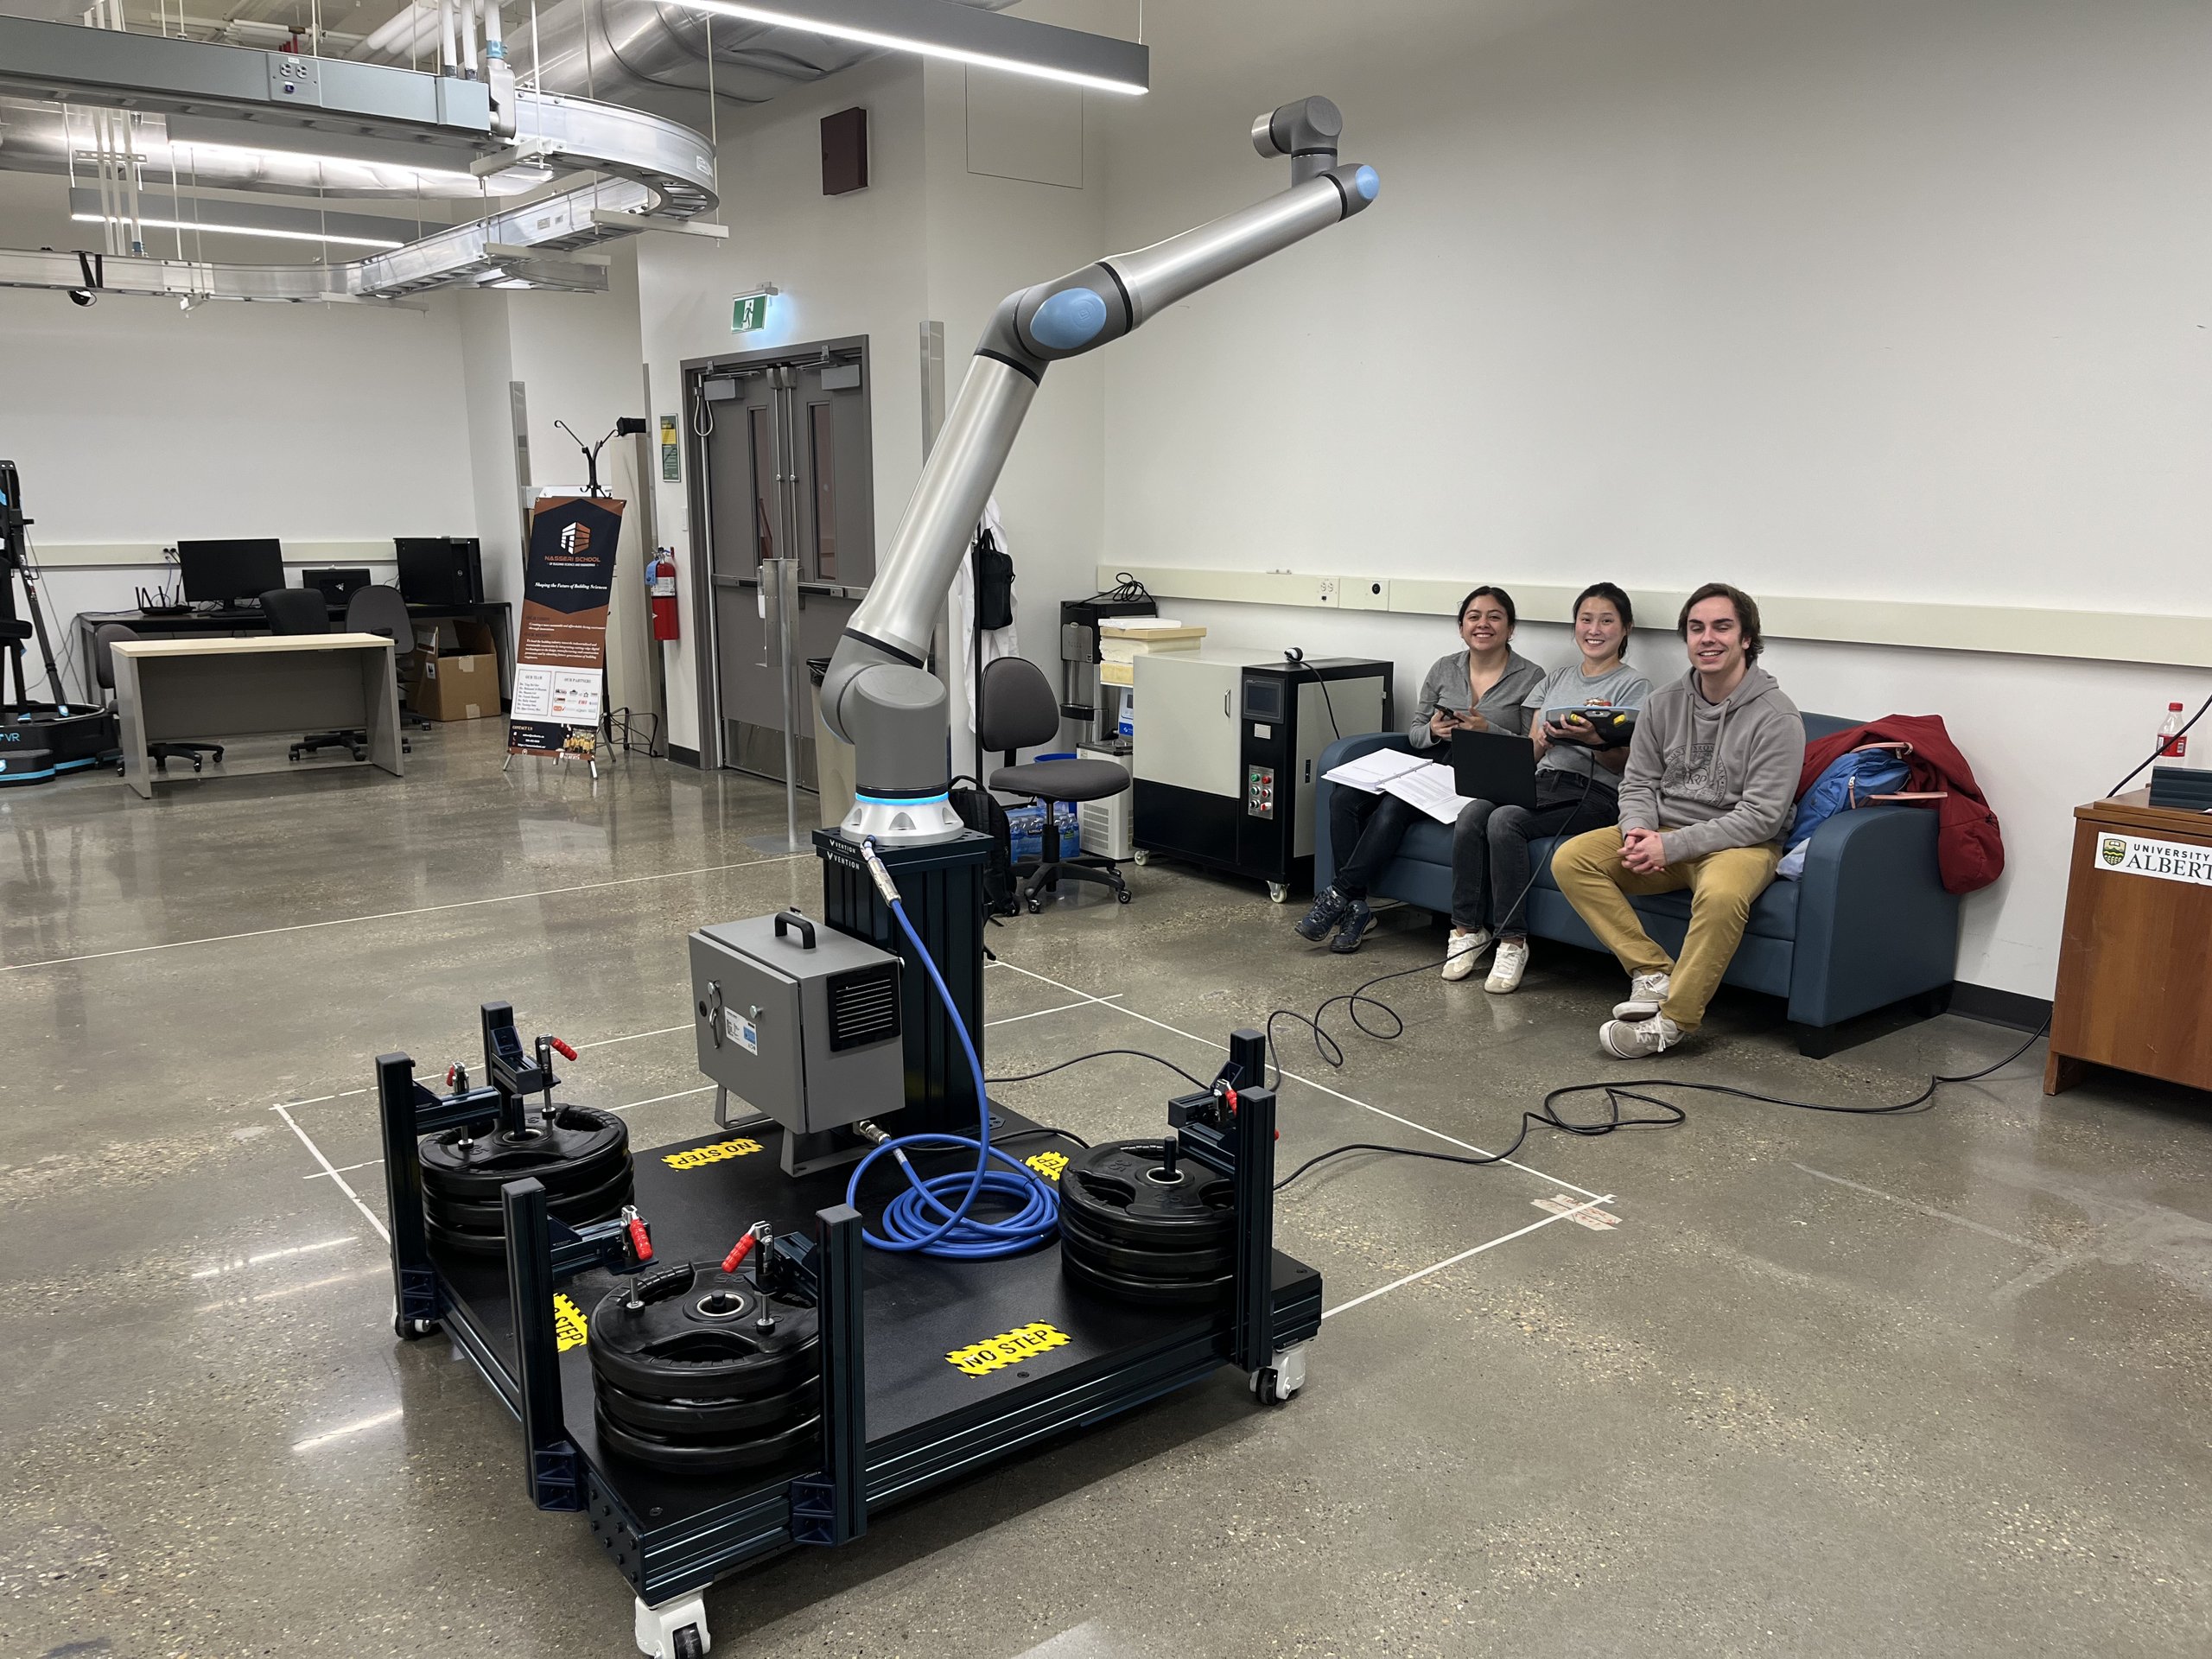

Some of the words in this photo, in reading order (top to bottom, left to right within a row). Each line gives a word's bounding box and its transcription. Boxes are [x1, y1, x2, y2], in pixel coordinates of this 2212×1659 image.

[836, 842, 856, 854] VENTION
[2133, 843, 2210, 861] UNIVERSITY
[834, 855, 860, 870] VENTION
[2126, 853, 2212, 880] ALBERT
[725, 1141, 753, 1153] NO
[677, 1149, 721, 1165] STEP
[1036, 1158, 1064, 1173] TEP
[962, 1350, 997, 1368] NO
[997, 1330, 1047, 1354] STEP
